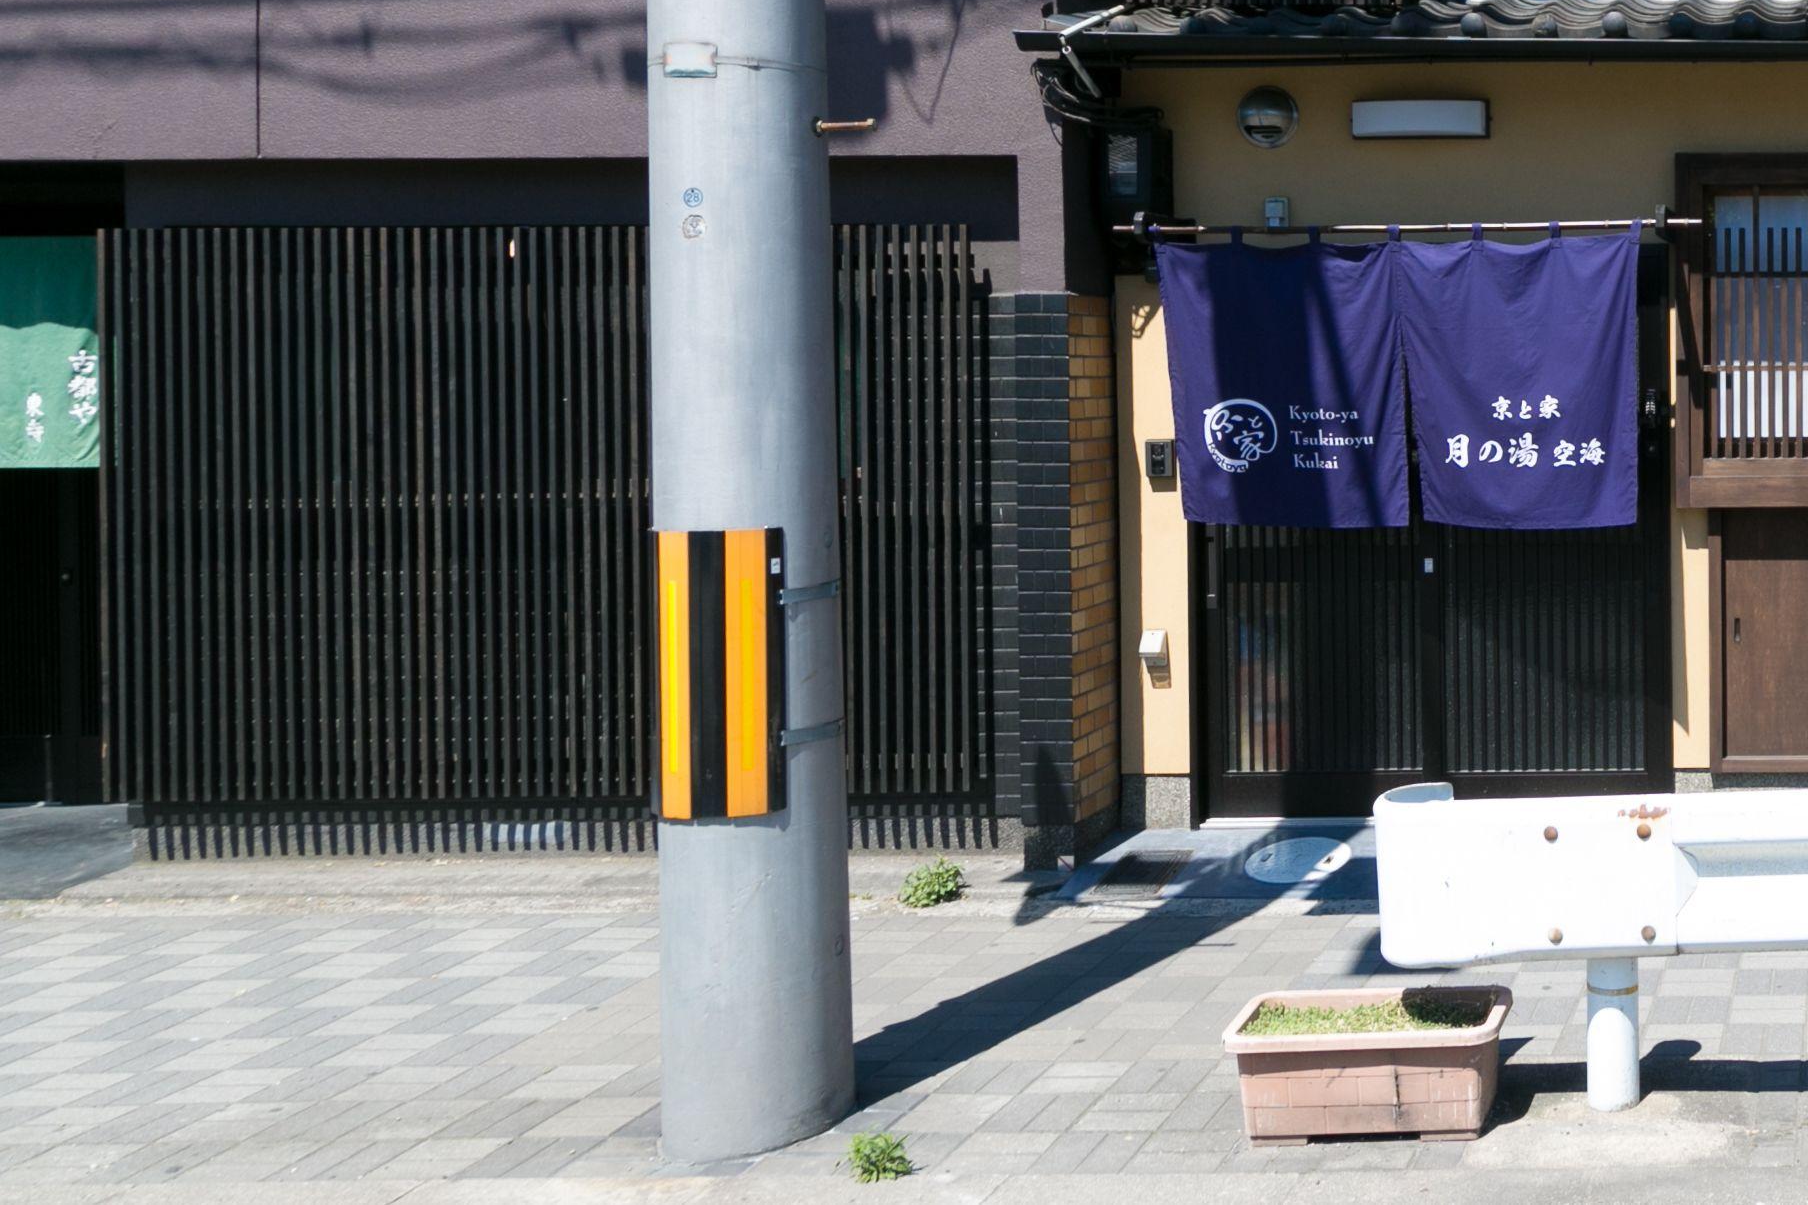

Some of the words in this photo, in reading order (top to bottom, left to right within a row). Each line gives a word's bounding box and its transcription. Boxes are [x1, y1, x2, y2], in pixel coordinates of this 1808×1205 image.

[686, 191, 700, 203] 28
[67, 349, 98, 425] 古都や
[25, 392, 45, 444] 東寺
[1288, 405, 1359, 423] Kyoto-ya
[1491, 394, 1562, 421] 京と家
[1289, 428, 1375, 448] Tsukinoyu
[1293, 452, 1340, 470] Kukai
[1445, 432, 1540, 468] 月の湯
[1553, 437, 1606, 467] 空海
